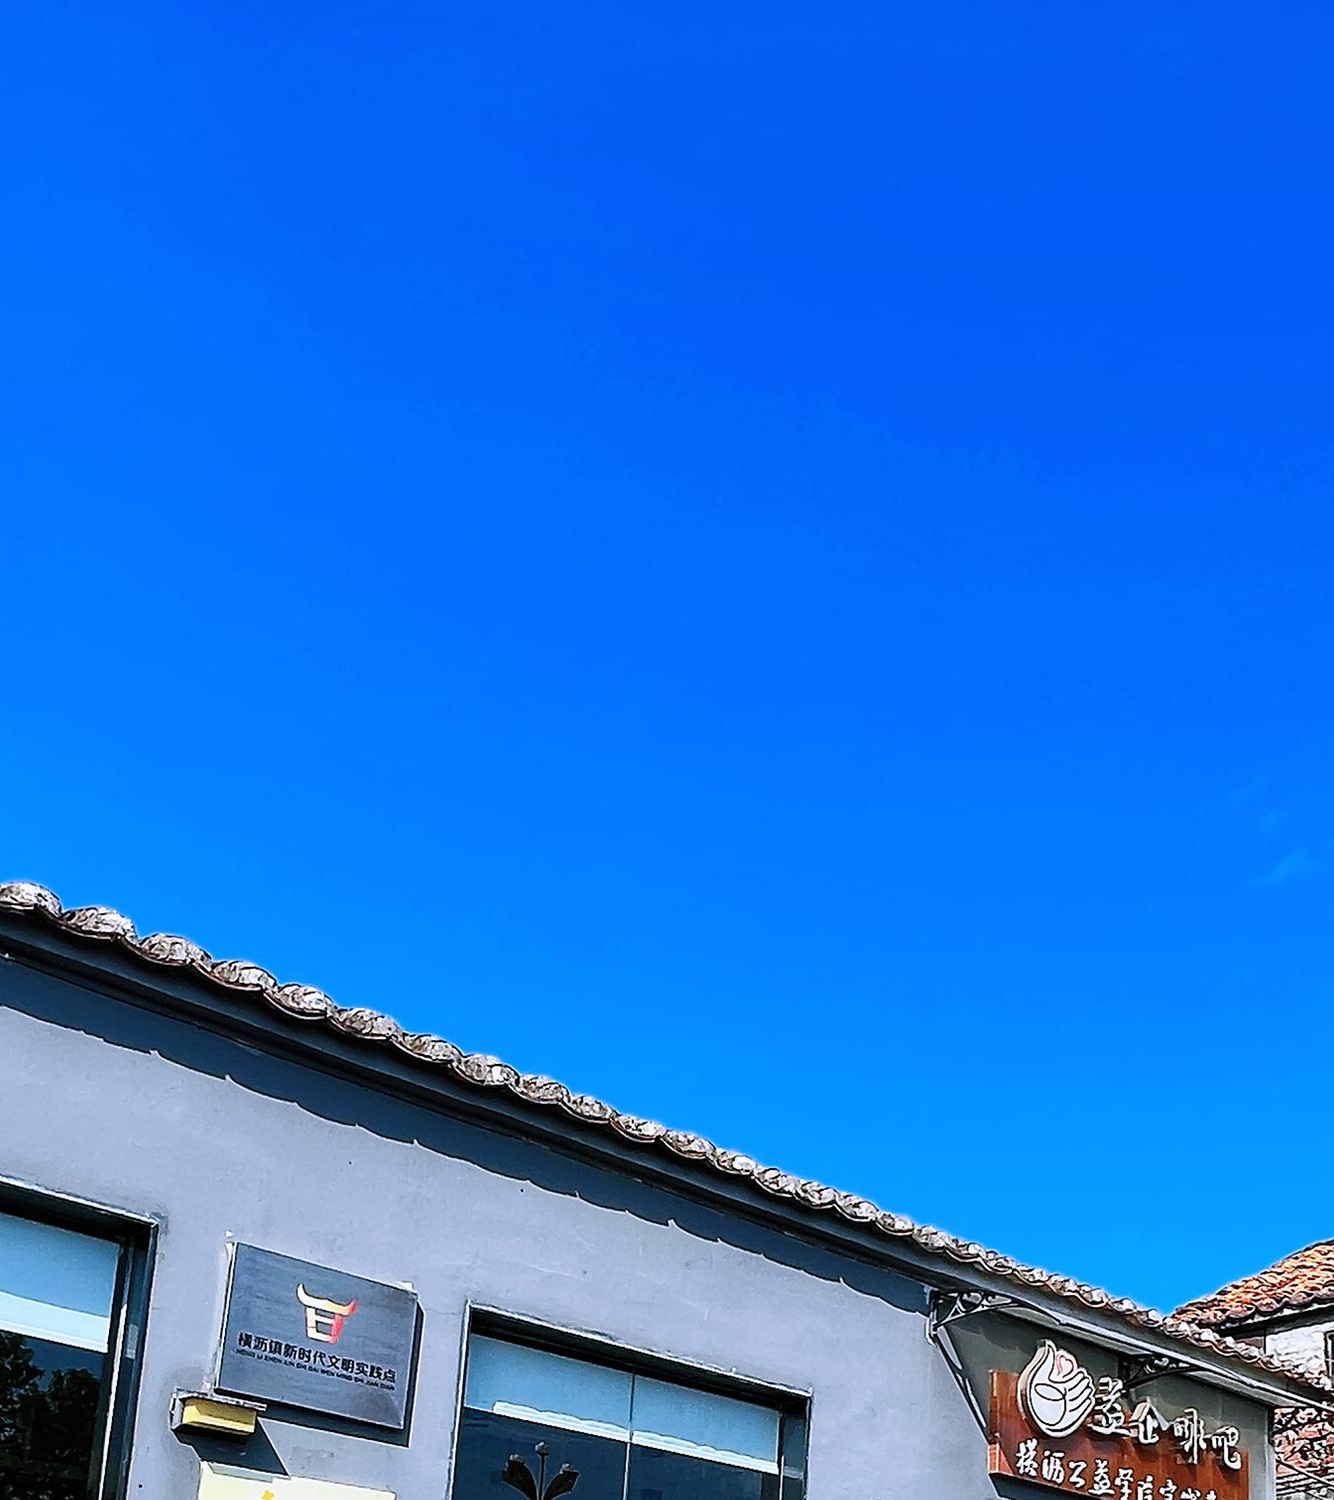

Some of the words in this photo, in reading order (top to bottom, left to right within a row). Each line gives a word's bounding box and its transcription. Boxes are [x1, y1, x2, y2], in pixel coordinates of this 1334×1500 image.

[238, 1332, 396, 1383] 横沥镇新时代文明实践点
